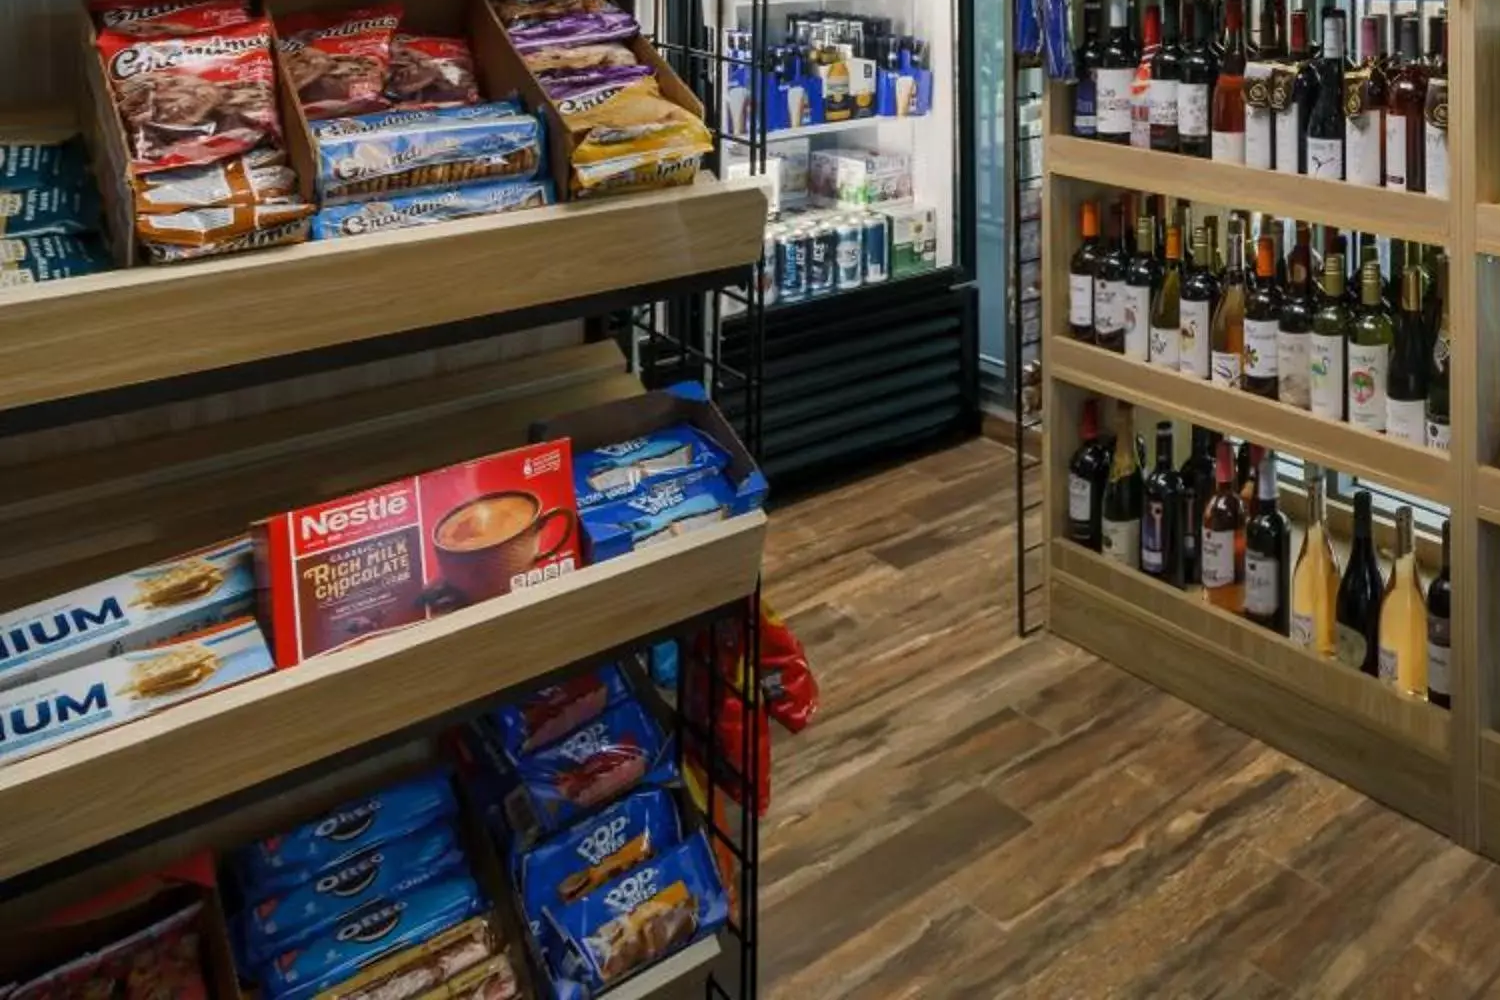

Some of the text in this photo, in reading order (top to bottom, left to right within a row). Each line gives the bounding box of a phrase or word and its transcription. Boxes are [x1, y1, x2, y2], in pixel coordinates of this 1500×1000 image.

[367, 540, 409, 567] MILK
[315, 553, 410, 600] CHOCOLATE
[576, 815, 630, 858] POP
[315, 851, 386, 894] OREO
[603, 866, 659, 908] POP
[336, 900, 409, 942] OREO
